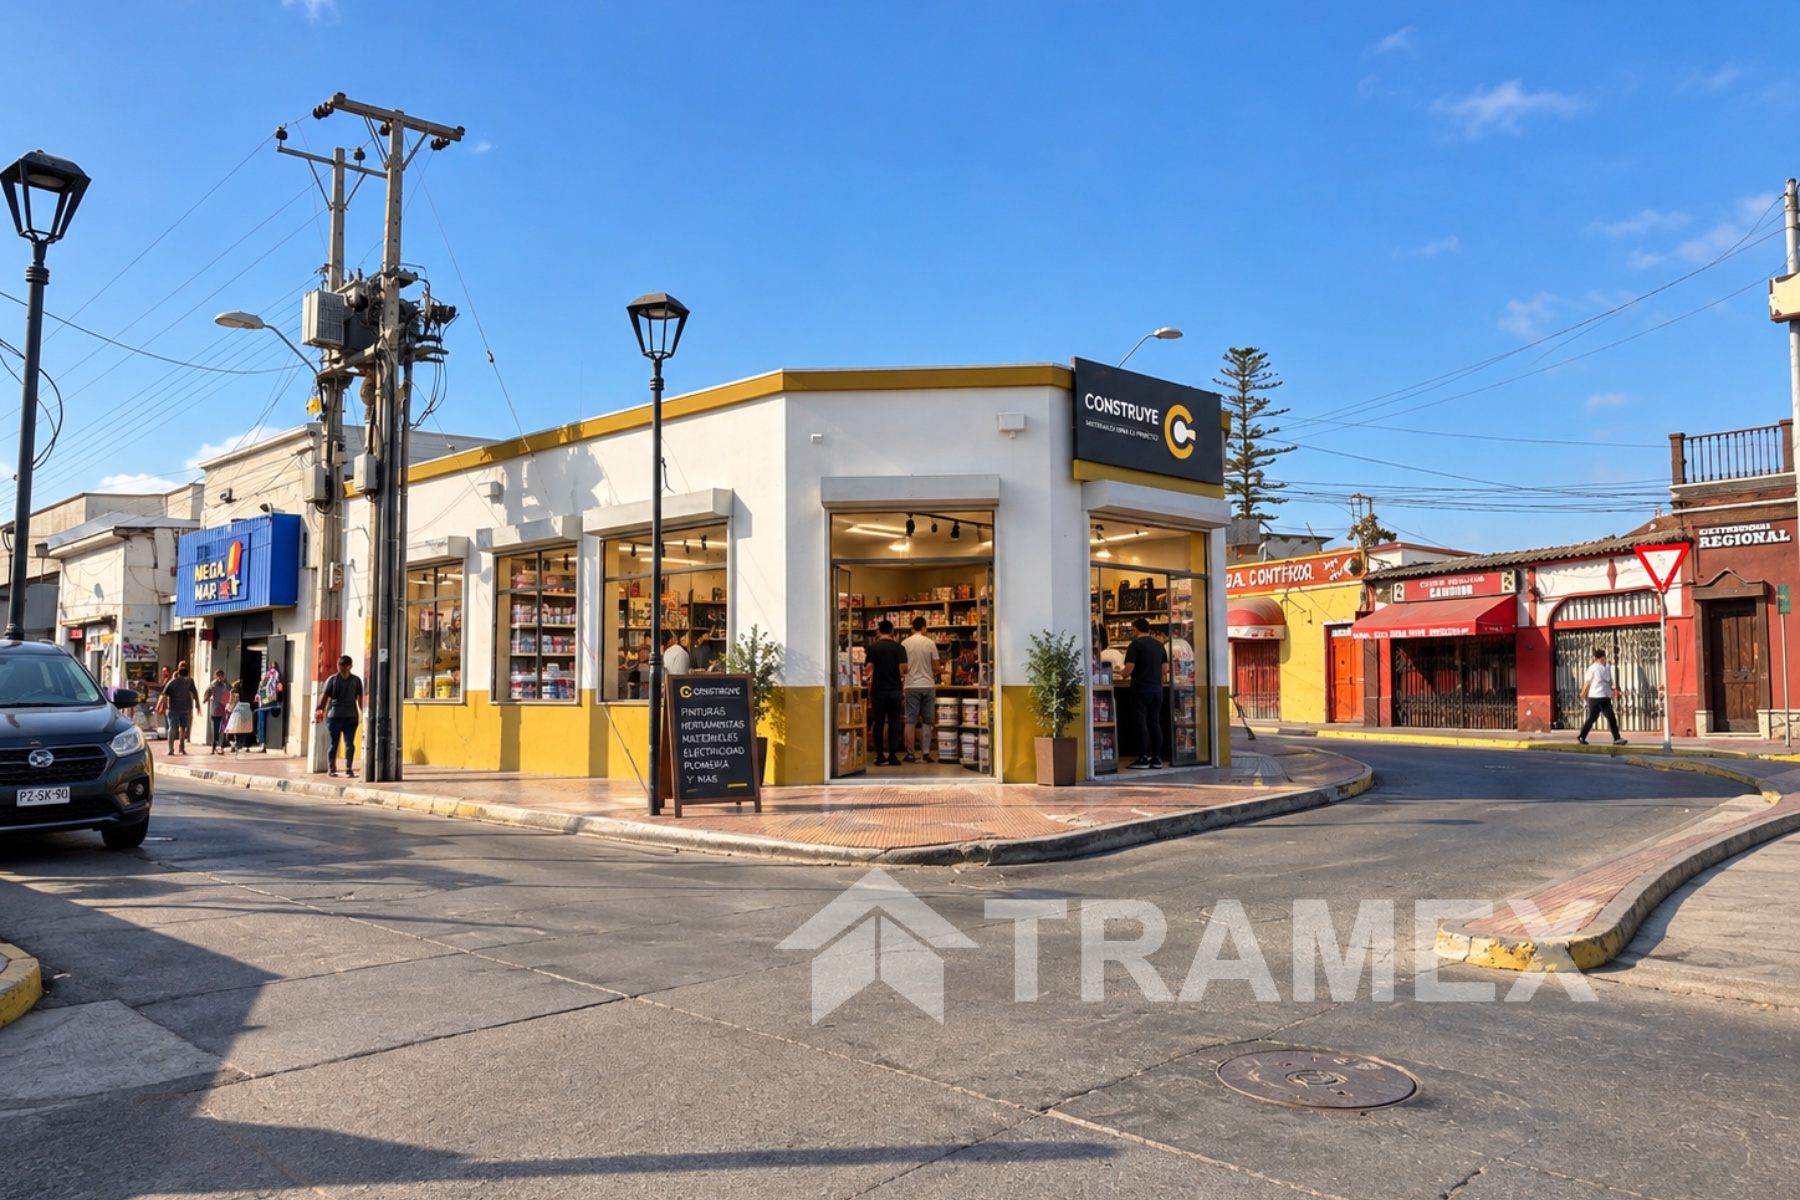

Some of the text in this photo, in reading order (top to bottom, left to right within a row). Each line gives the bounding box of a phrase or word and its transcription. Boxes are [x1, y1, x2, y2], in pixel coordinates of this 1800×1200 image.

[1084, 393, 1159, 425] CONSTRUYE
[1699, 530, 1791, 548] REGIONAL
[681, 707, 726, 717] PINTURAS
[686, 775, 694, 784] Y
